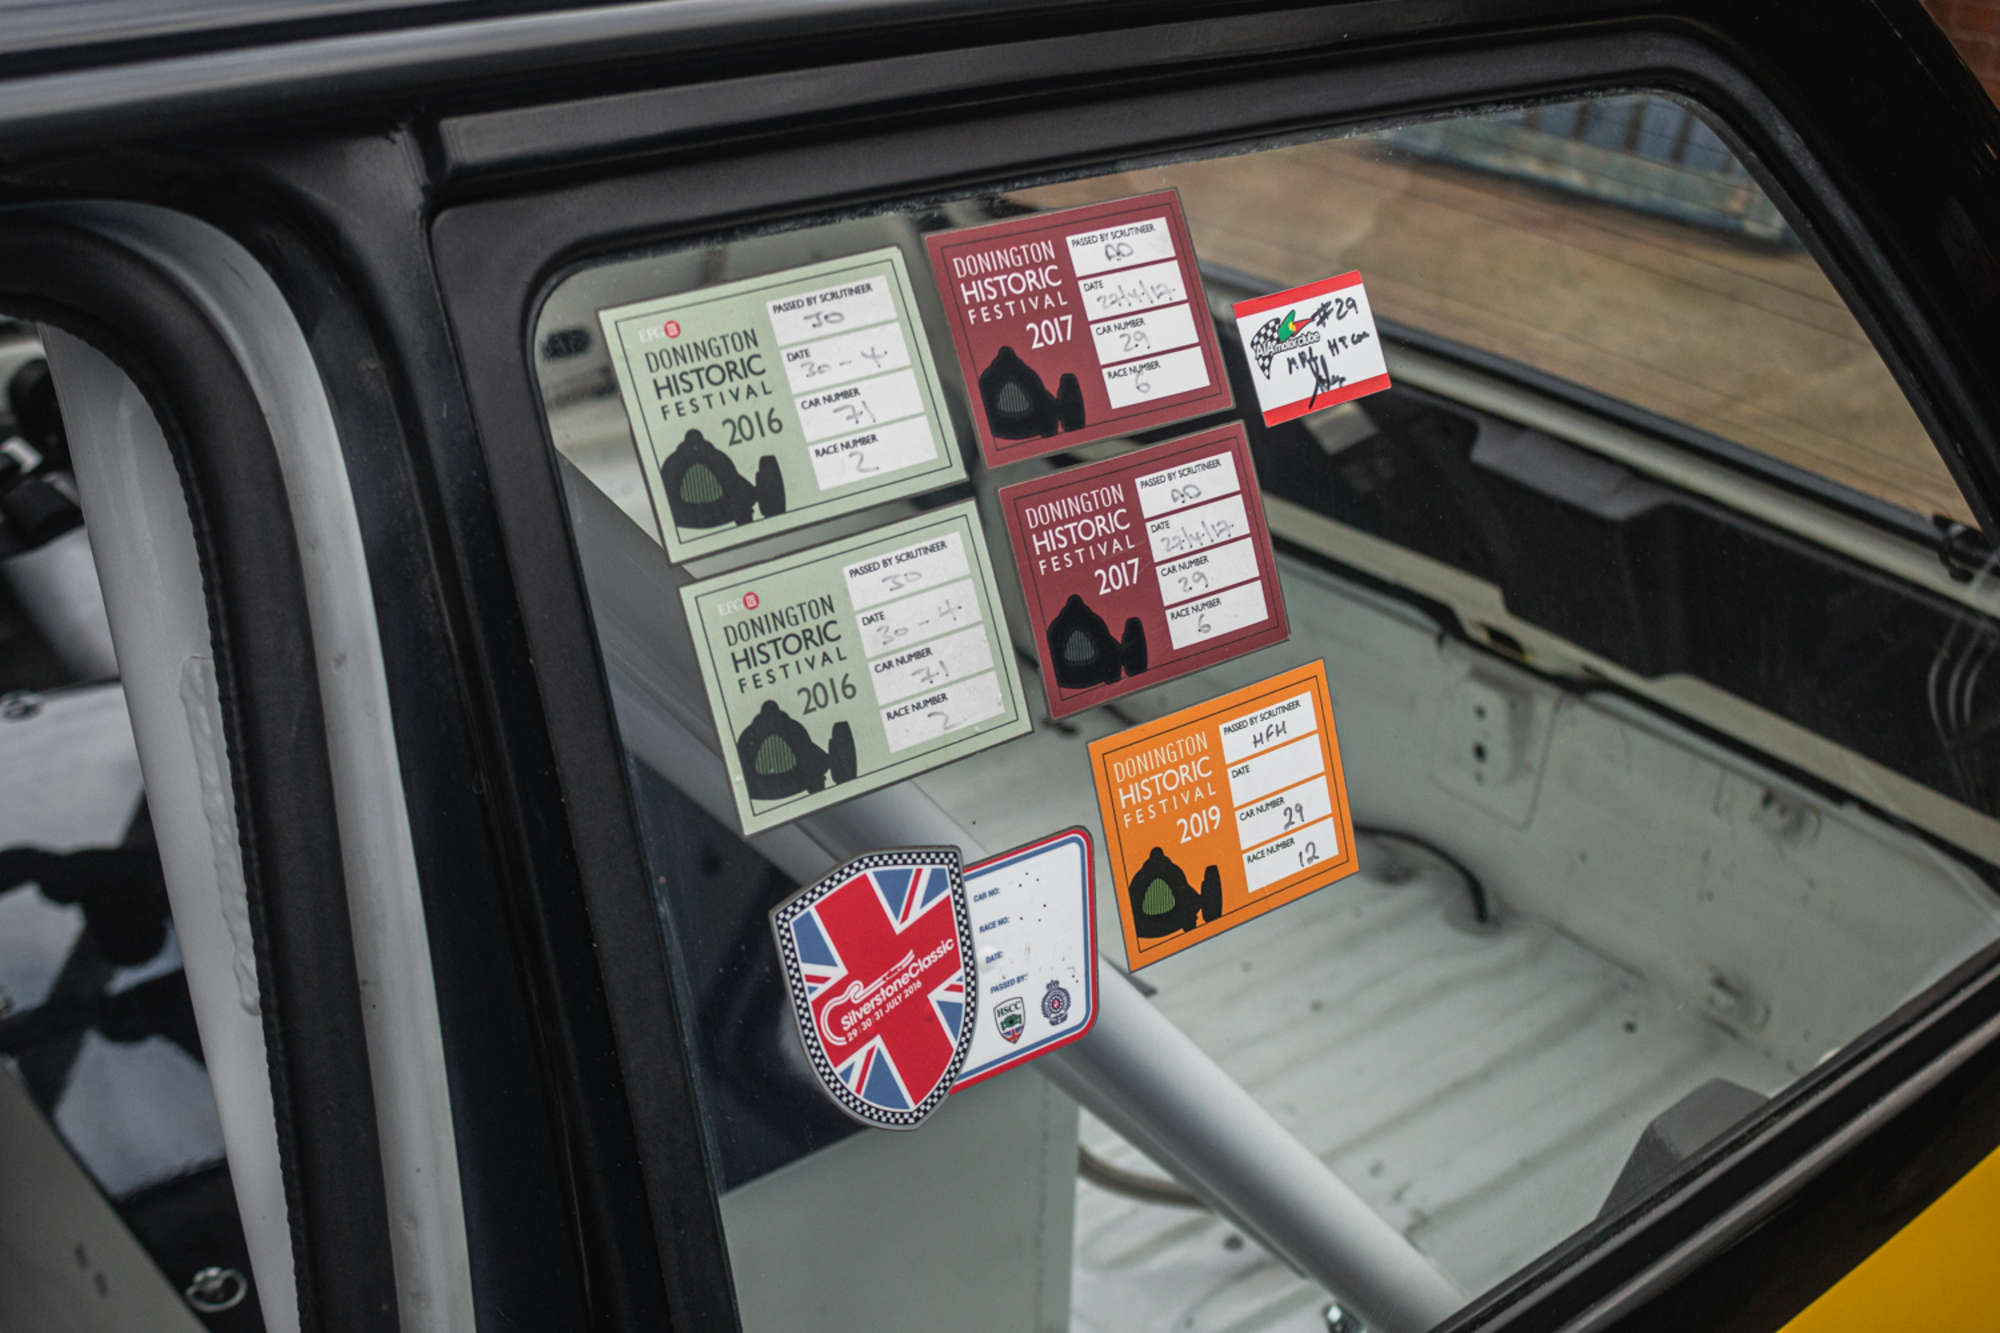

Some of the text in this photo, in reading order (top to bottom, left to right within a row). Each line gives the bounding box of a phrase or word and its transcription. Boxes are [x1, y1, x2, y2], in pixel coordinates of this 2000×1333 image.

[1071, 224, 1155, 248] PASSED BY SCRUTINEER
[953, 240, 1055, 278] DONINGTON
[773, 283, 873, 314] PASSED BY SCRUTINEER
[961, 265, 1062, 305] HISTORIC
[1084, 280, 1104, 292] DATE
[968, 291, 1068, 325] FESTIVAL
[1026, 315, 1072, 349] 2017
[1096, 318, 1146, 336] CAR NUMBER
[645, 328, 759, 373] DONINGTON
[787, 349, 811, 361] DATE
[1120, 331, 1150, 352] 29
[653, 354, 766, 400] HISTORIC
[1107, 360, 1160, 379] RACE NUMBER
[661, 381, 772, 421] FESTIVAL
[801, 388, 861, 409] CAR NUMBER
[722, 407, 783, 447] 2016
[814, 434, 878, 457] RACE NUMBER
[1140, 459, 1221, 489] PASSED BY SCRUTINEER
[1025, 483, 1124, 528] DONINGTON
[1032, 509, 1130, 555] HISTORIC
[1150, 520, 1171, 533] DATE
[849, 541, 948, 578] PASSED BY SCRUTINEER
[1038, 535, 1135, 575] FESTIVAL
[1161, 555, 1209, 576] CAR NUMBER
[1094, 558, 1139, 595] 2017
[1178, 571, 1208, 592] 29
[724, 594, 835, 647] DONINGTON
[862, 611, 885, 626] DATE
[1170, 598, 1222, 620] RACE NUMBER
[1198, 614, 1211, 633] 6
[731, 620, 841, 673] HISTORIC
[738, 647, 847, 694] FESTIVAL
[874, 648, 932, 674] CAR NUMBER
[797, 673, 856, 715] 2016
[886, 693, 948, 721] RACE NUMBER
[1223, 700, 1301, 735] PASSED BY SCRUTINEER
[1253, 721, 1287, 748] HFH
[1114, 731, 1207, 783] DONINGTON
[1118, 756, 1212, 808] HISTORIC
[1231, 765, 1250, 778] DATE
[1124, 782, 1216, 829] FESTIVAL
[1240, 796, 1285, 821] CAR NUMBER
[1283, 803, 1305, 830] 29
[1177, 805, 1221, 844] 2019
[1247, 838, 1295, 864] RACE NUMBER
[1299, 841, 1320, 867] 12
[973, 890, 987, 903] CAR
[979, 920, 997, 933] RACE
[990, 978, 1016, 994] PASSED
[847, 981, 922, 1042] 29 30 31 JULY 2016
[997, 1001, 1021, 1017] HSCC
